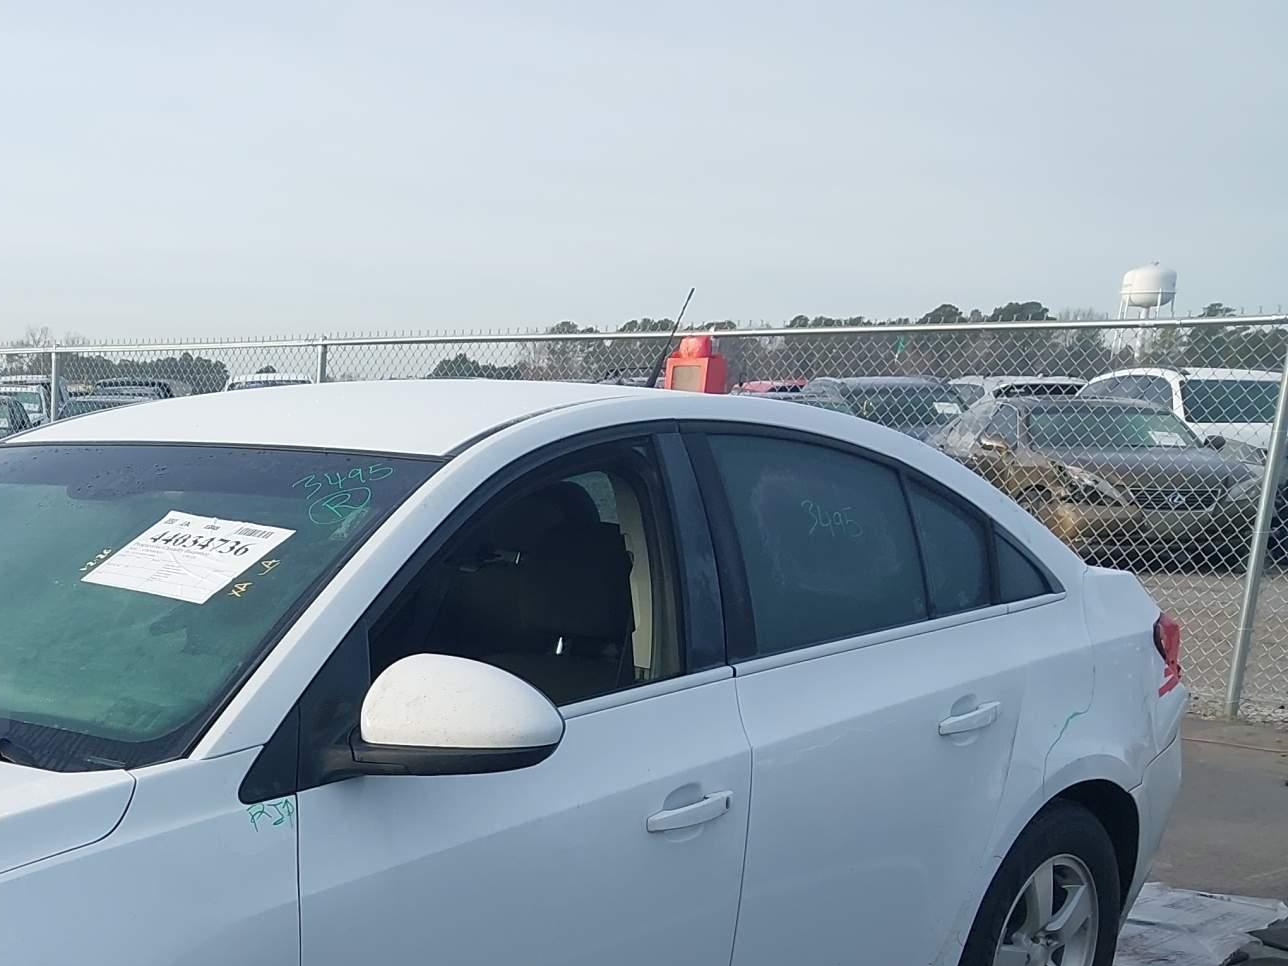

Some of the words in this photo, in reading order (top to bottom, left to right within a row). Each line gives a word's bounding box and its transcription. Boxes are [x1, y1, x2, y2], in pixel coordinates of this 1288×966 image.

[292, 463, 393, 500] 3495
[800, 498, 864, 537] 3495
[150, 530, 256, 557] 44034736
